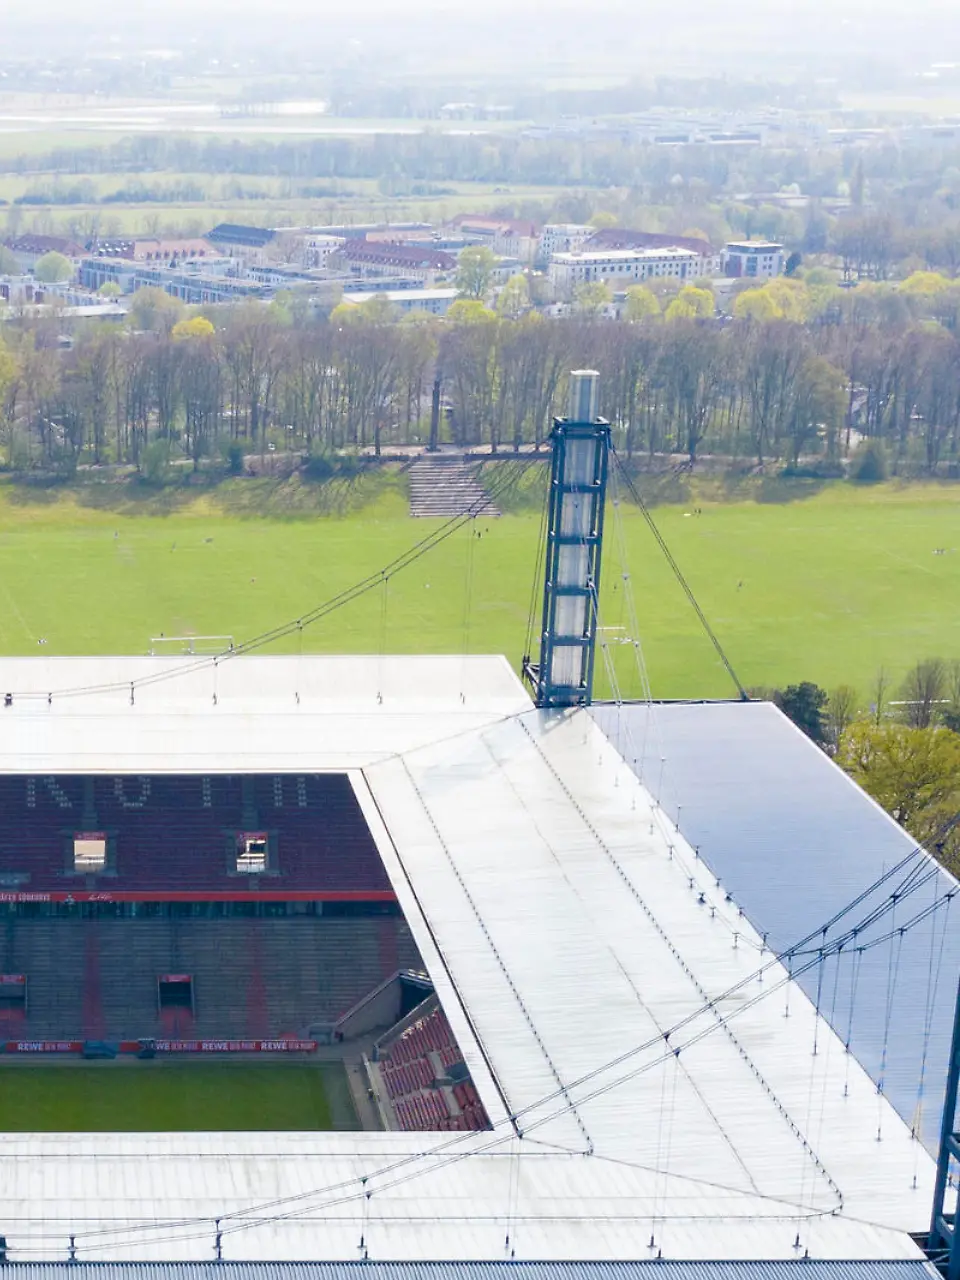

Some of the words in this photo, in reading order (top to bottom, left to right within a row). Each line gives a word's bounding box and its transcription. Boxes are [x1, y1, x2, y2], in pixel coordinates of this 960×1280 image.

[18, 1042, 43, 1051] REWE
[202, 1042, 228, 1051] REWE
[261, 1042, 287, 1051] REWE
